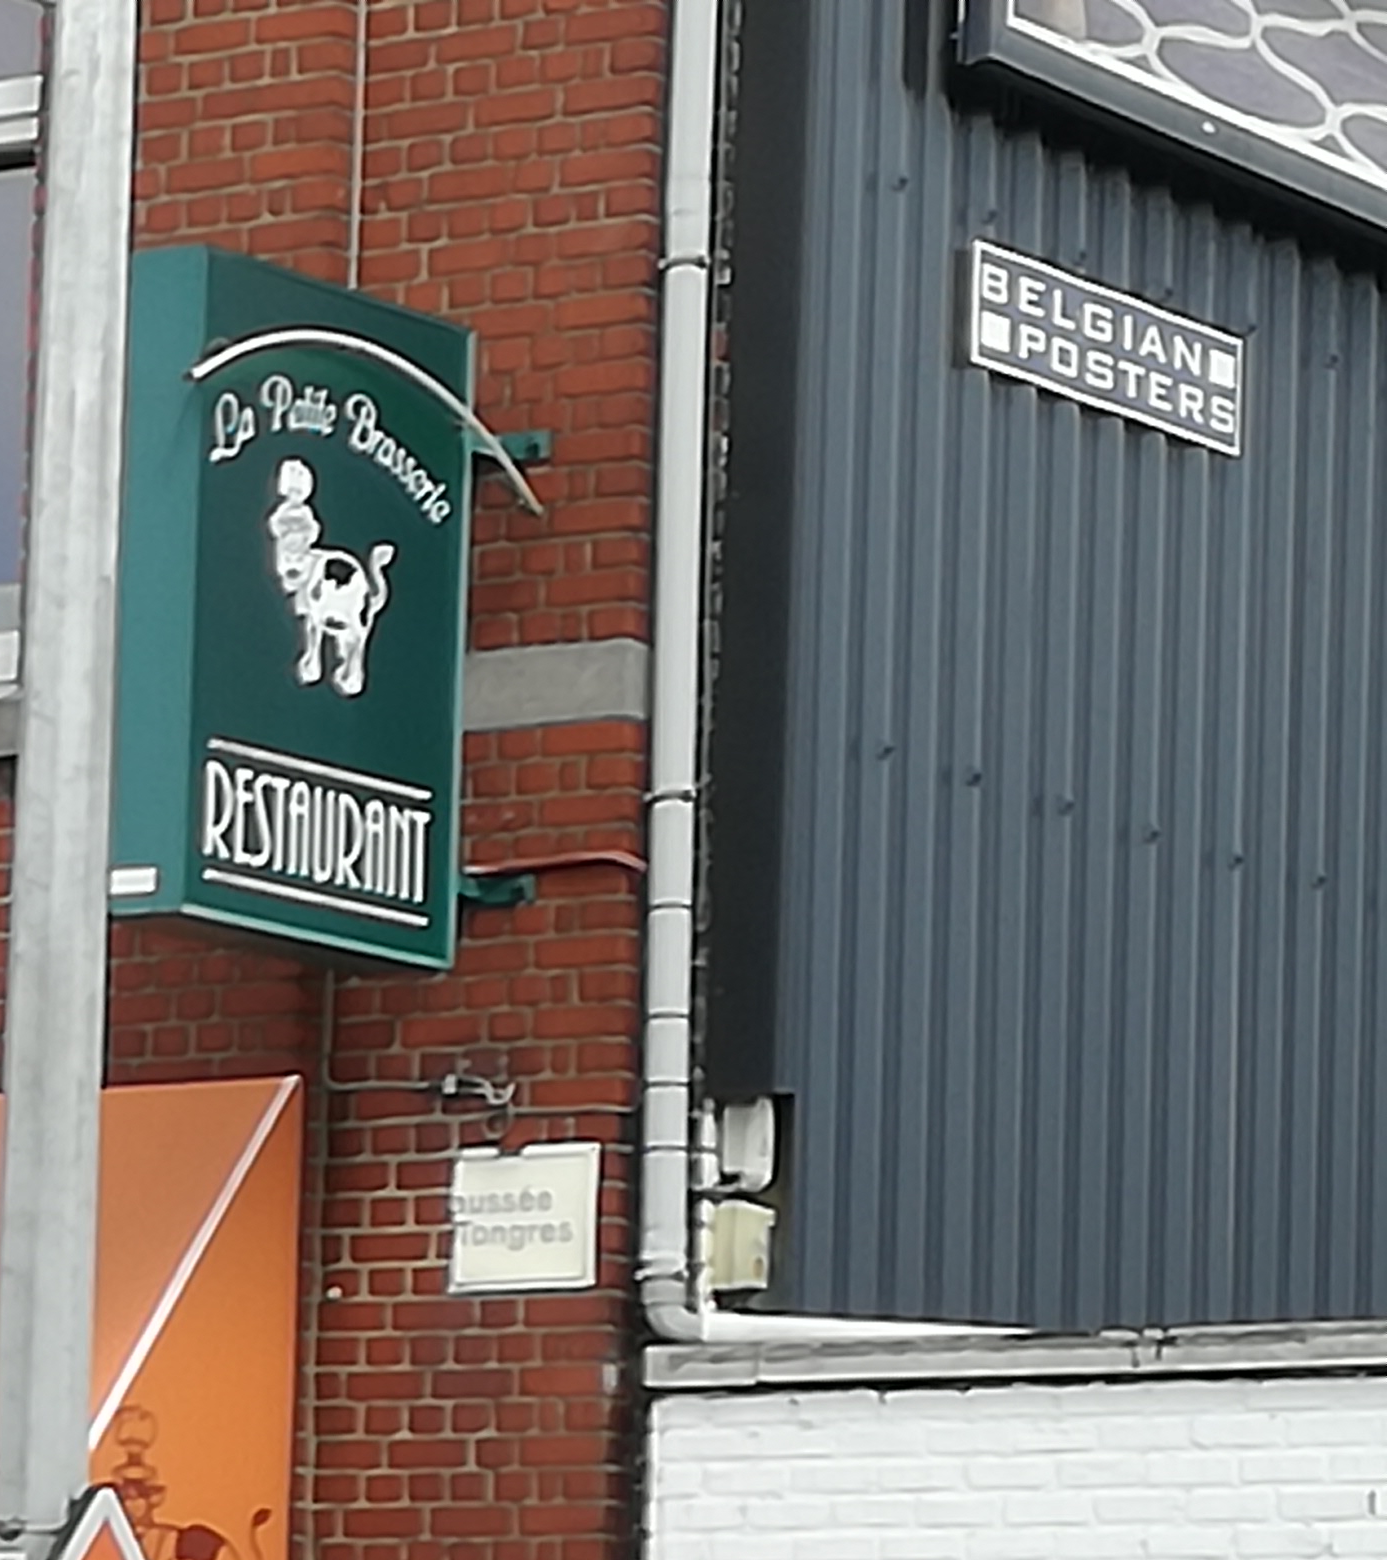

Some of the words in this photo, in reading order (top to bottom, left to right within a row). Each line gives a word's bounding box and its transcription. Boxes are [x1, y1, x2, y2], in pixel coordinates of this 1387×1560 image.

[981, 262, 1201, 377] BELGIAN
[1019, 324, 1236, 433] POSTERS
[210, 393, 255, 462] La
[346, 393, 451, 524] Brasserie
[202, 759, 430, 902] RESTAURANT
